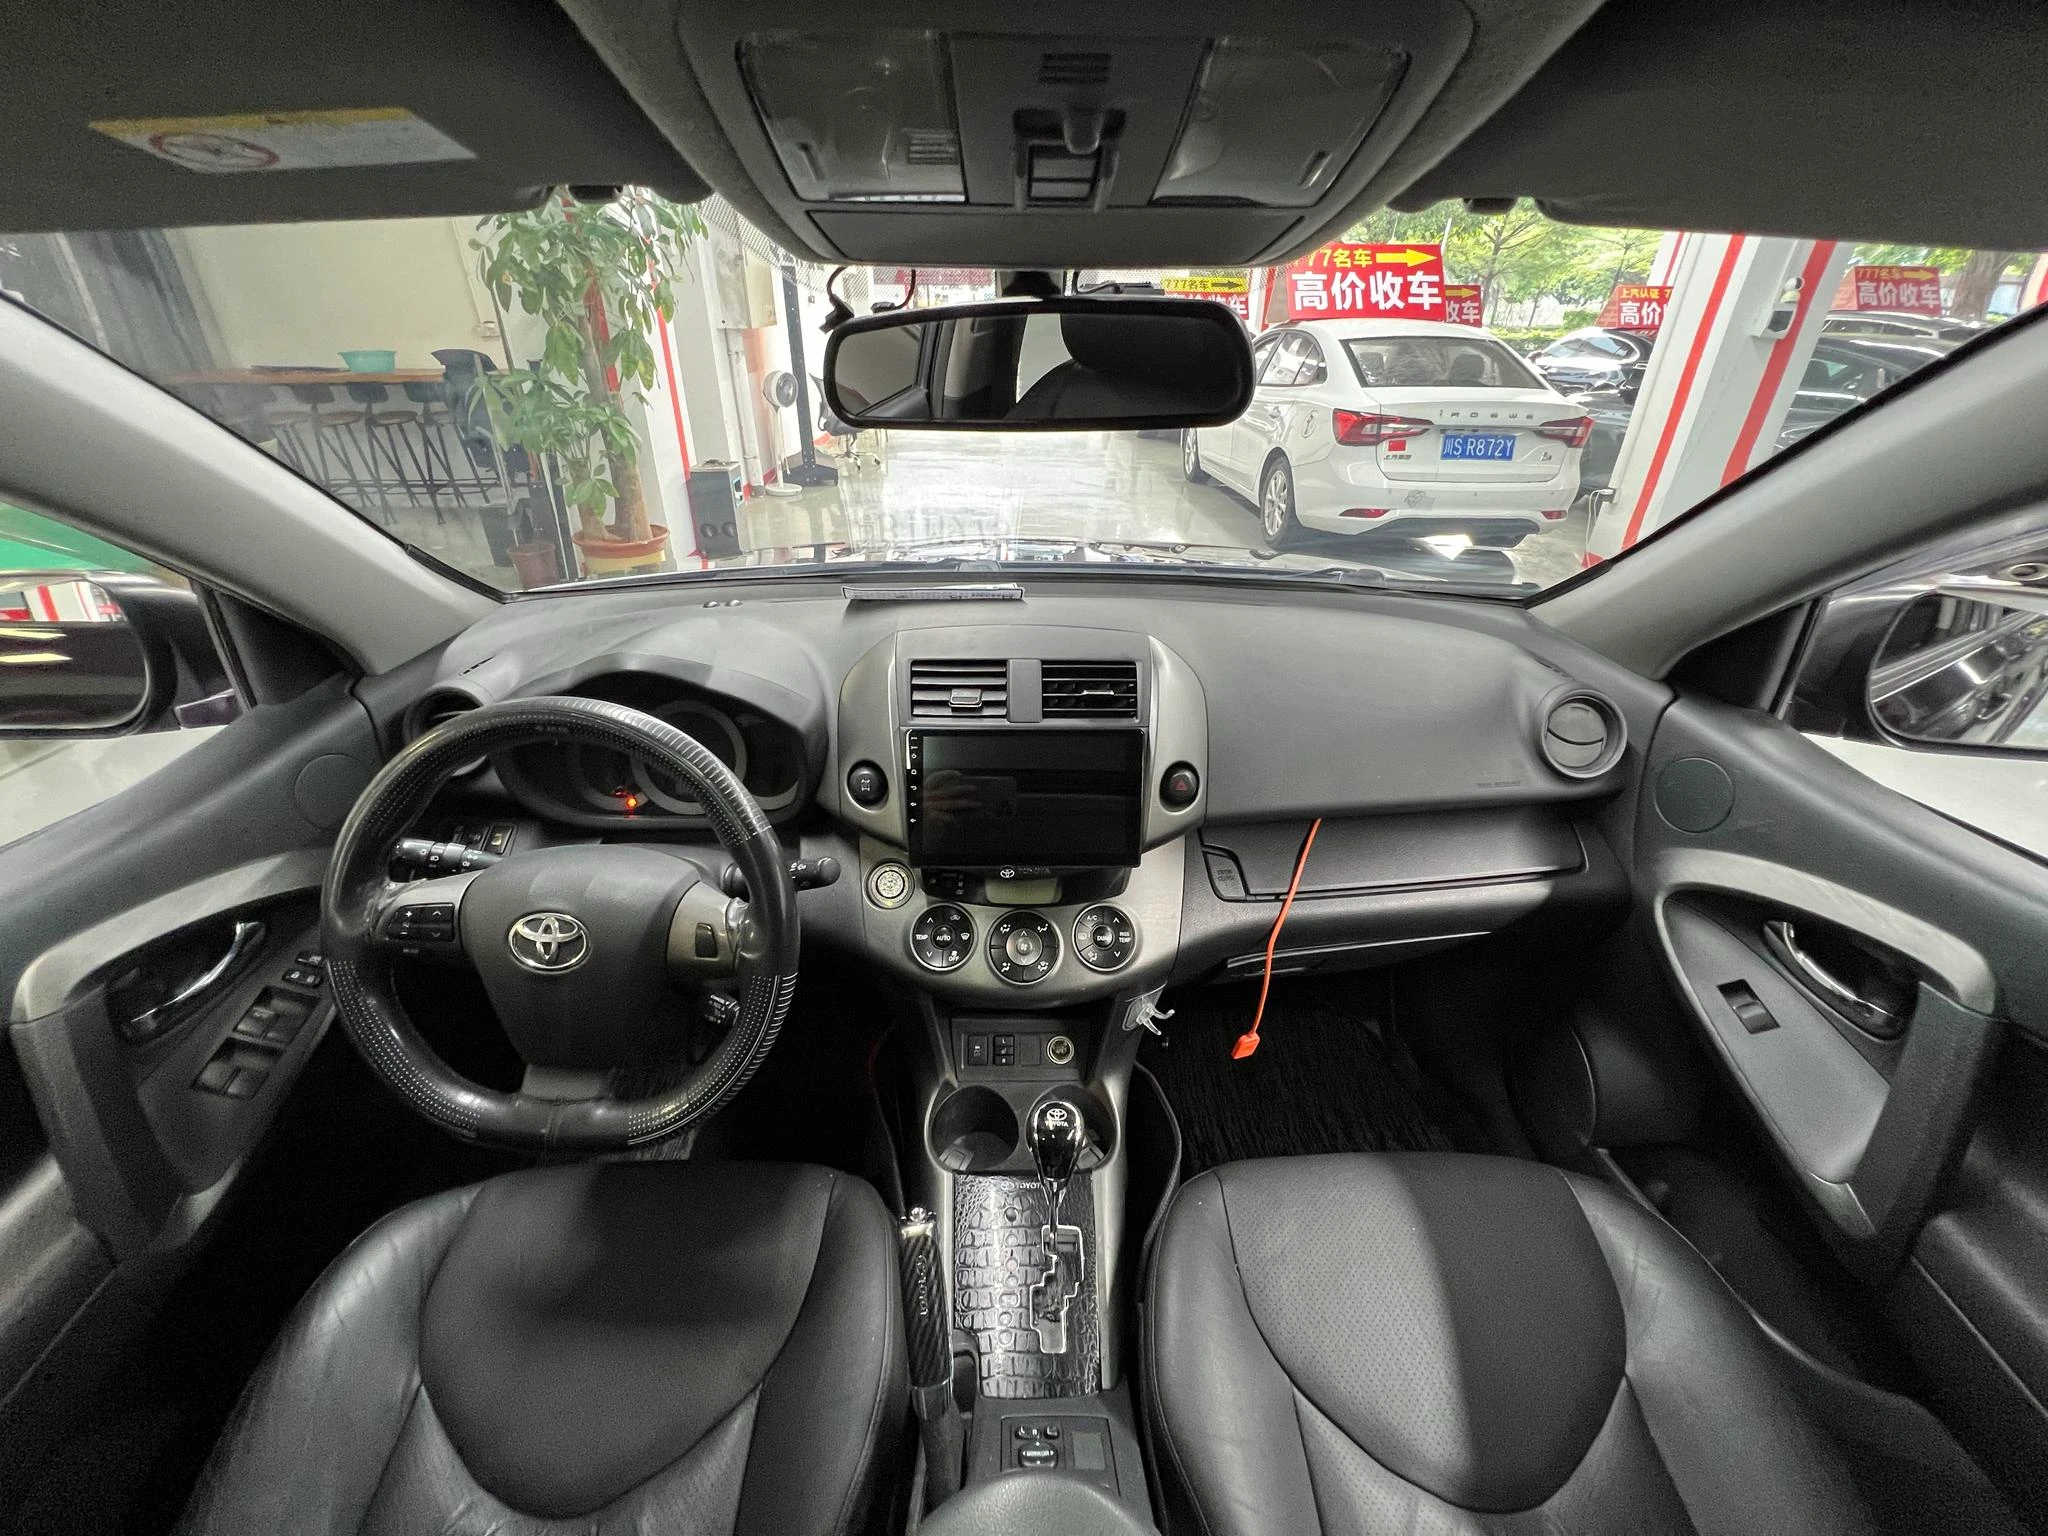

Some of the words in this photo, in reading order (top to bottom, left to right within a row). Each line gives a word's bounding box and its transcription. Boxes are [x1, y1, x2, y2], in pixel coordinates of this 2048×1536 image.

[1294, 248, 1373, 268] 77名车
[1291, 271, 1443, 311] 高价收车
[1858, 281, 1940, 309] 高价收车
[1620, 301, 1668, 326] 高价
